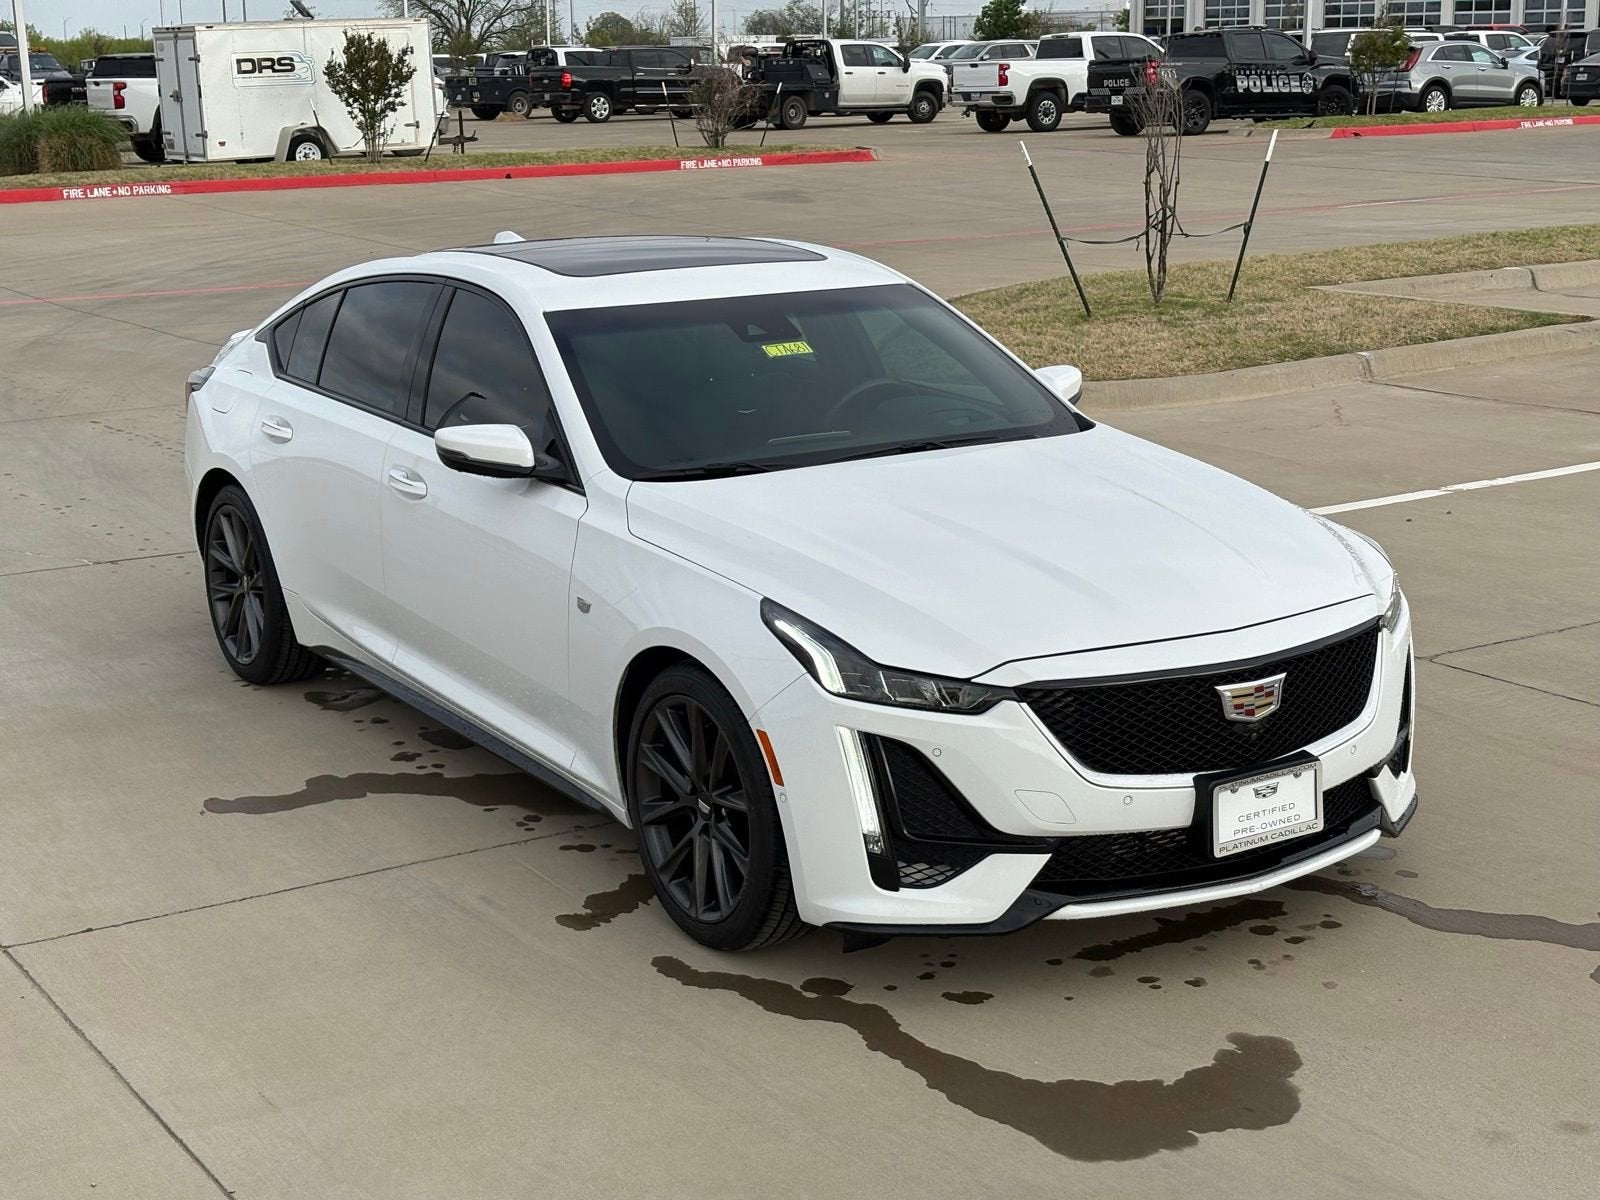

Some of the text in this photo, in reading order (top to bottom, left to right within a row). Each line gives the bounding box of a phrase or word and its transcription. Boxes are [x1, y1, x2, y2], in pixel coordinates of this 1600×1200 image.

[236, 57, 296, 74] DRS
[1103, 79, 1130, 87] POLICE
[1235, 75, 1302, 92] POLICE
[680, 157, 762, 169] FIRE LANE NO PARKING
[63, 185, 171, 199] FIRE LANE NO PARKING
[1218, 762, 1317, 791] PLATINUMCADILLAC.COM
[1238, 802, 1296, 823] CERTIFIED
[1233, 813, 1301, 837] PRE-OWNED
[1219, 822, 1319, 854] PLATINUM CADILLAC
